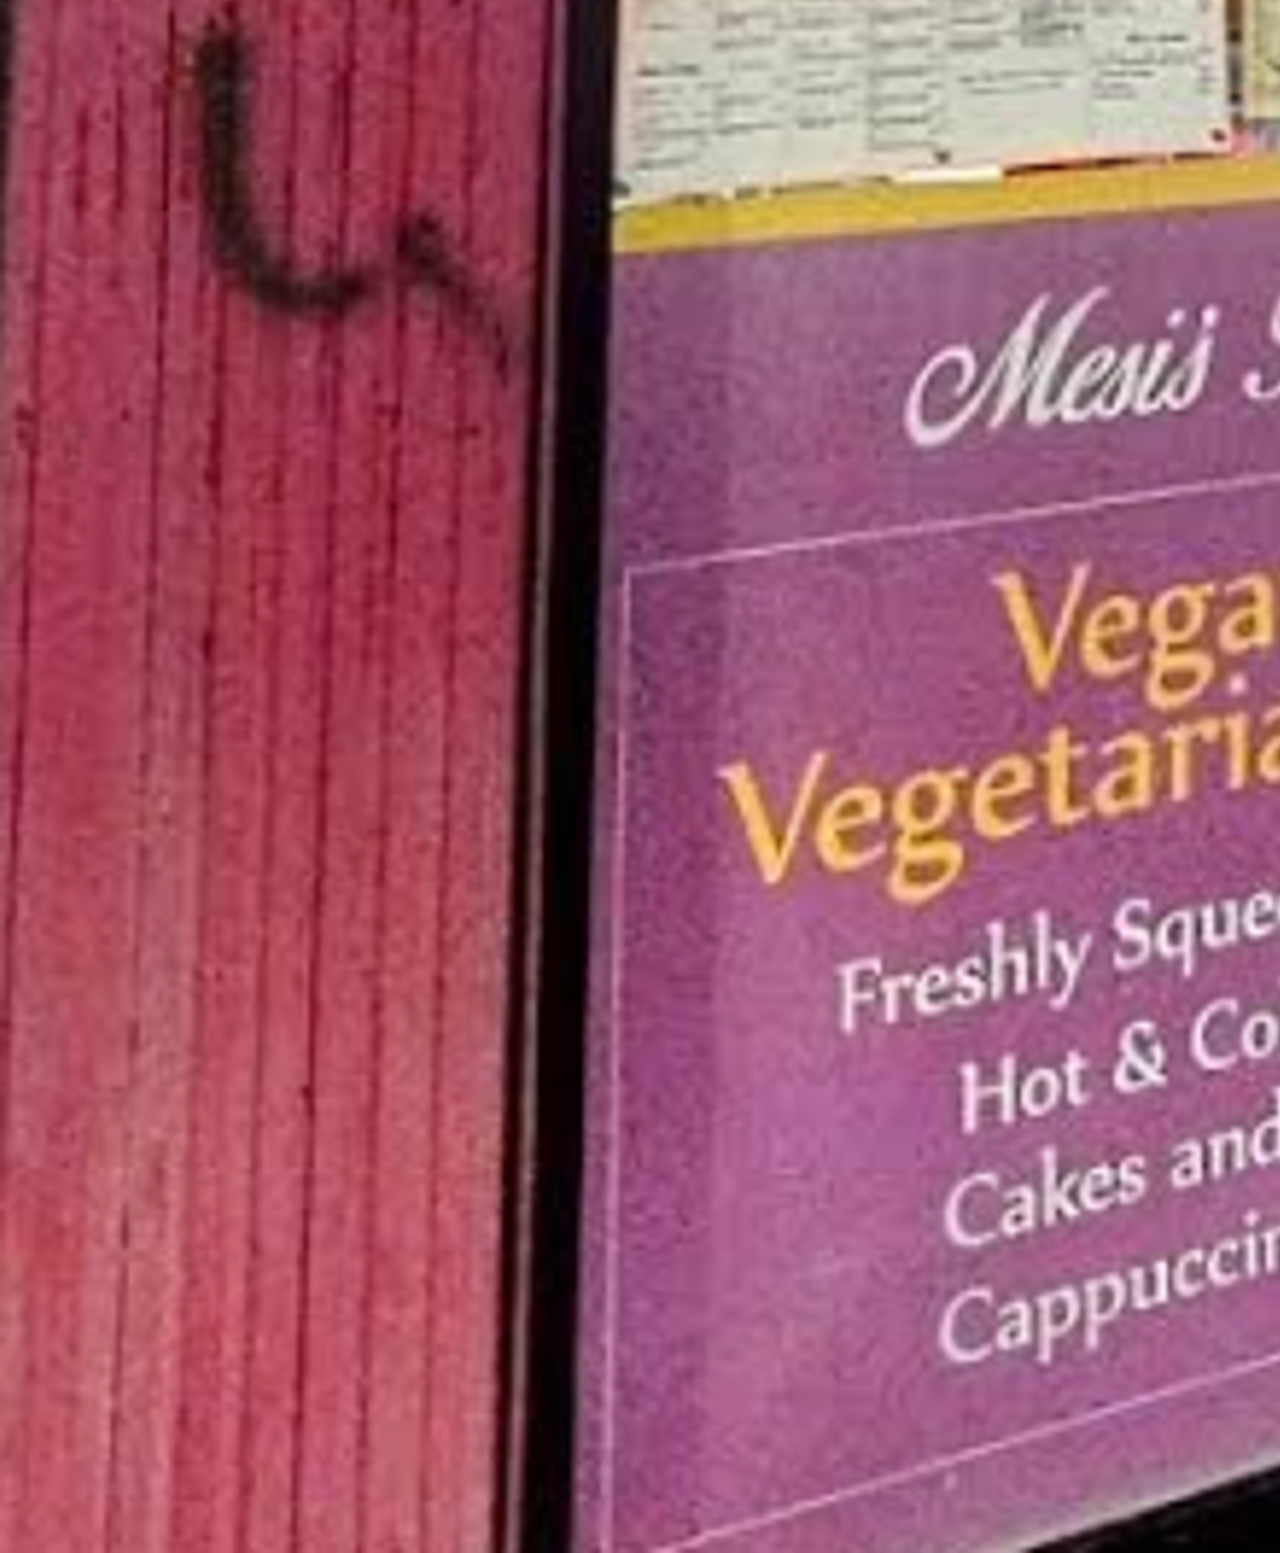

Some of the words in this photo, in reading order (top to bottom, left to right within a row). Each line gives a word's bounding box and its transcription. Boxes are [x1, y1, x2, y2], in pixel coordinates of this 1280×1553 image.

[904, 285, 1221, 448] Mesi's
[836, 908, 1092, 1035] Freshly
[958, 1049, 1088, 1136] Hot
[1113, 1022, 1167, 1094] &
[942, 1147, 1148, 1250] Cakes
